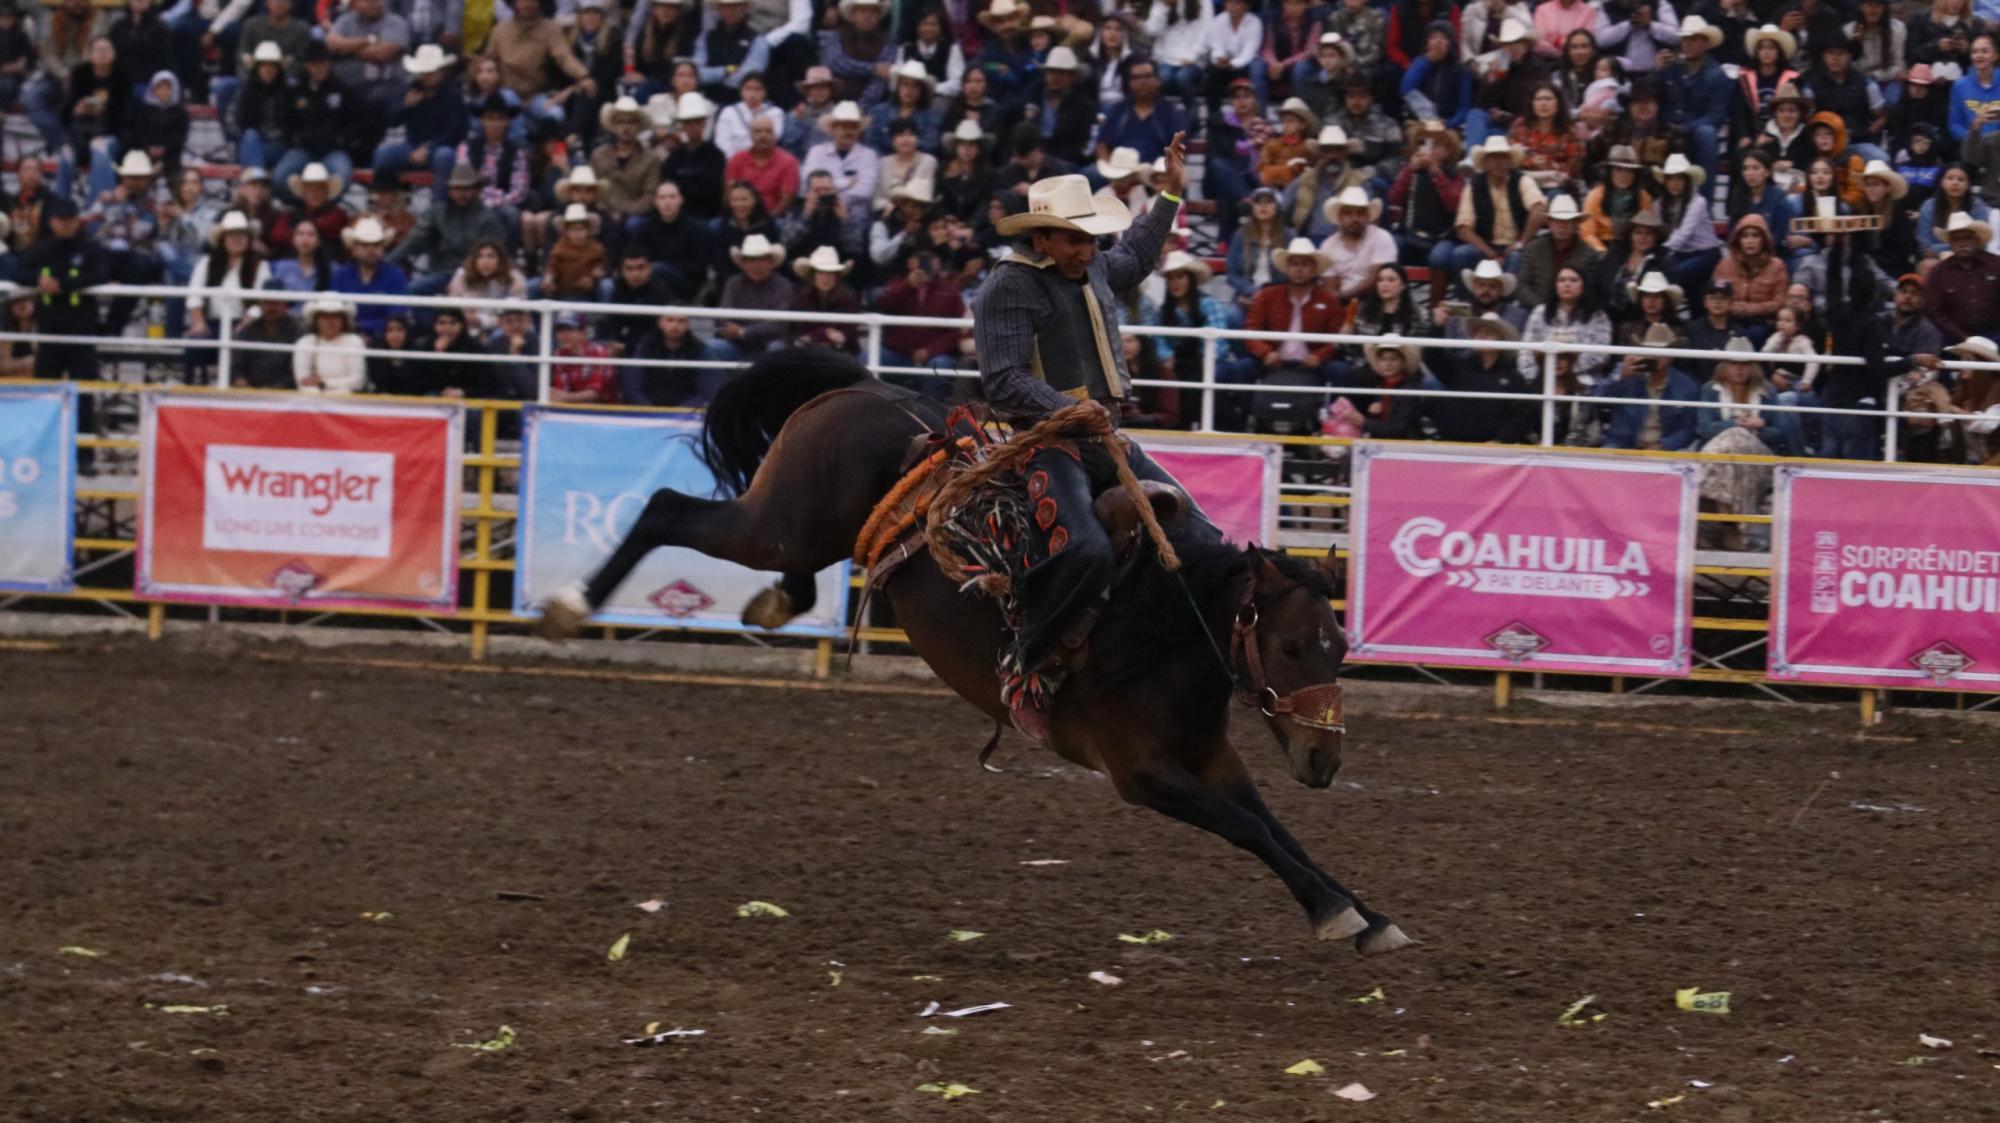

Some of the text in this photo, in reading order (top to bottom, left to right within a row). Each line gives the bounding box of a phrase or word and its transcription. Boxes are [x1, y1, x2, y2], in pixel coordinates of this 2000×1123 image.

[0, 456, 40, 485] O
[219, 460, 381, 516] Wrangler
[1389, 516, 1651, 577] COAHUILA
[1841, 543, 2000, 574] SORPRÉNDET
[1520, 575, 1604, 594] DELANTE
[1840, 569, 2000, 613] COAHUI
